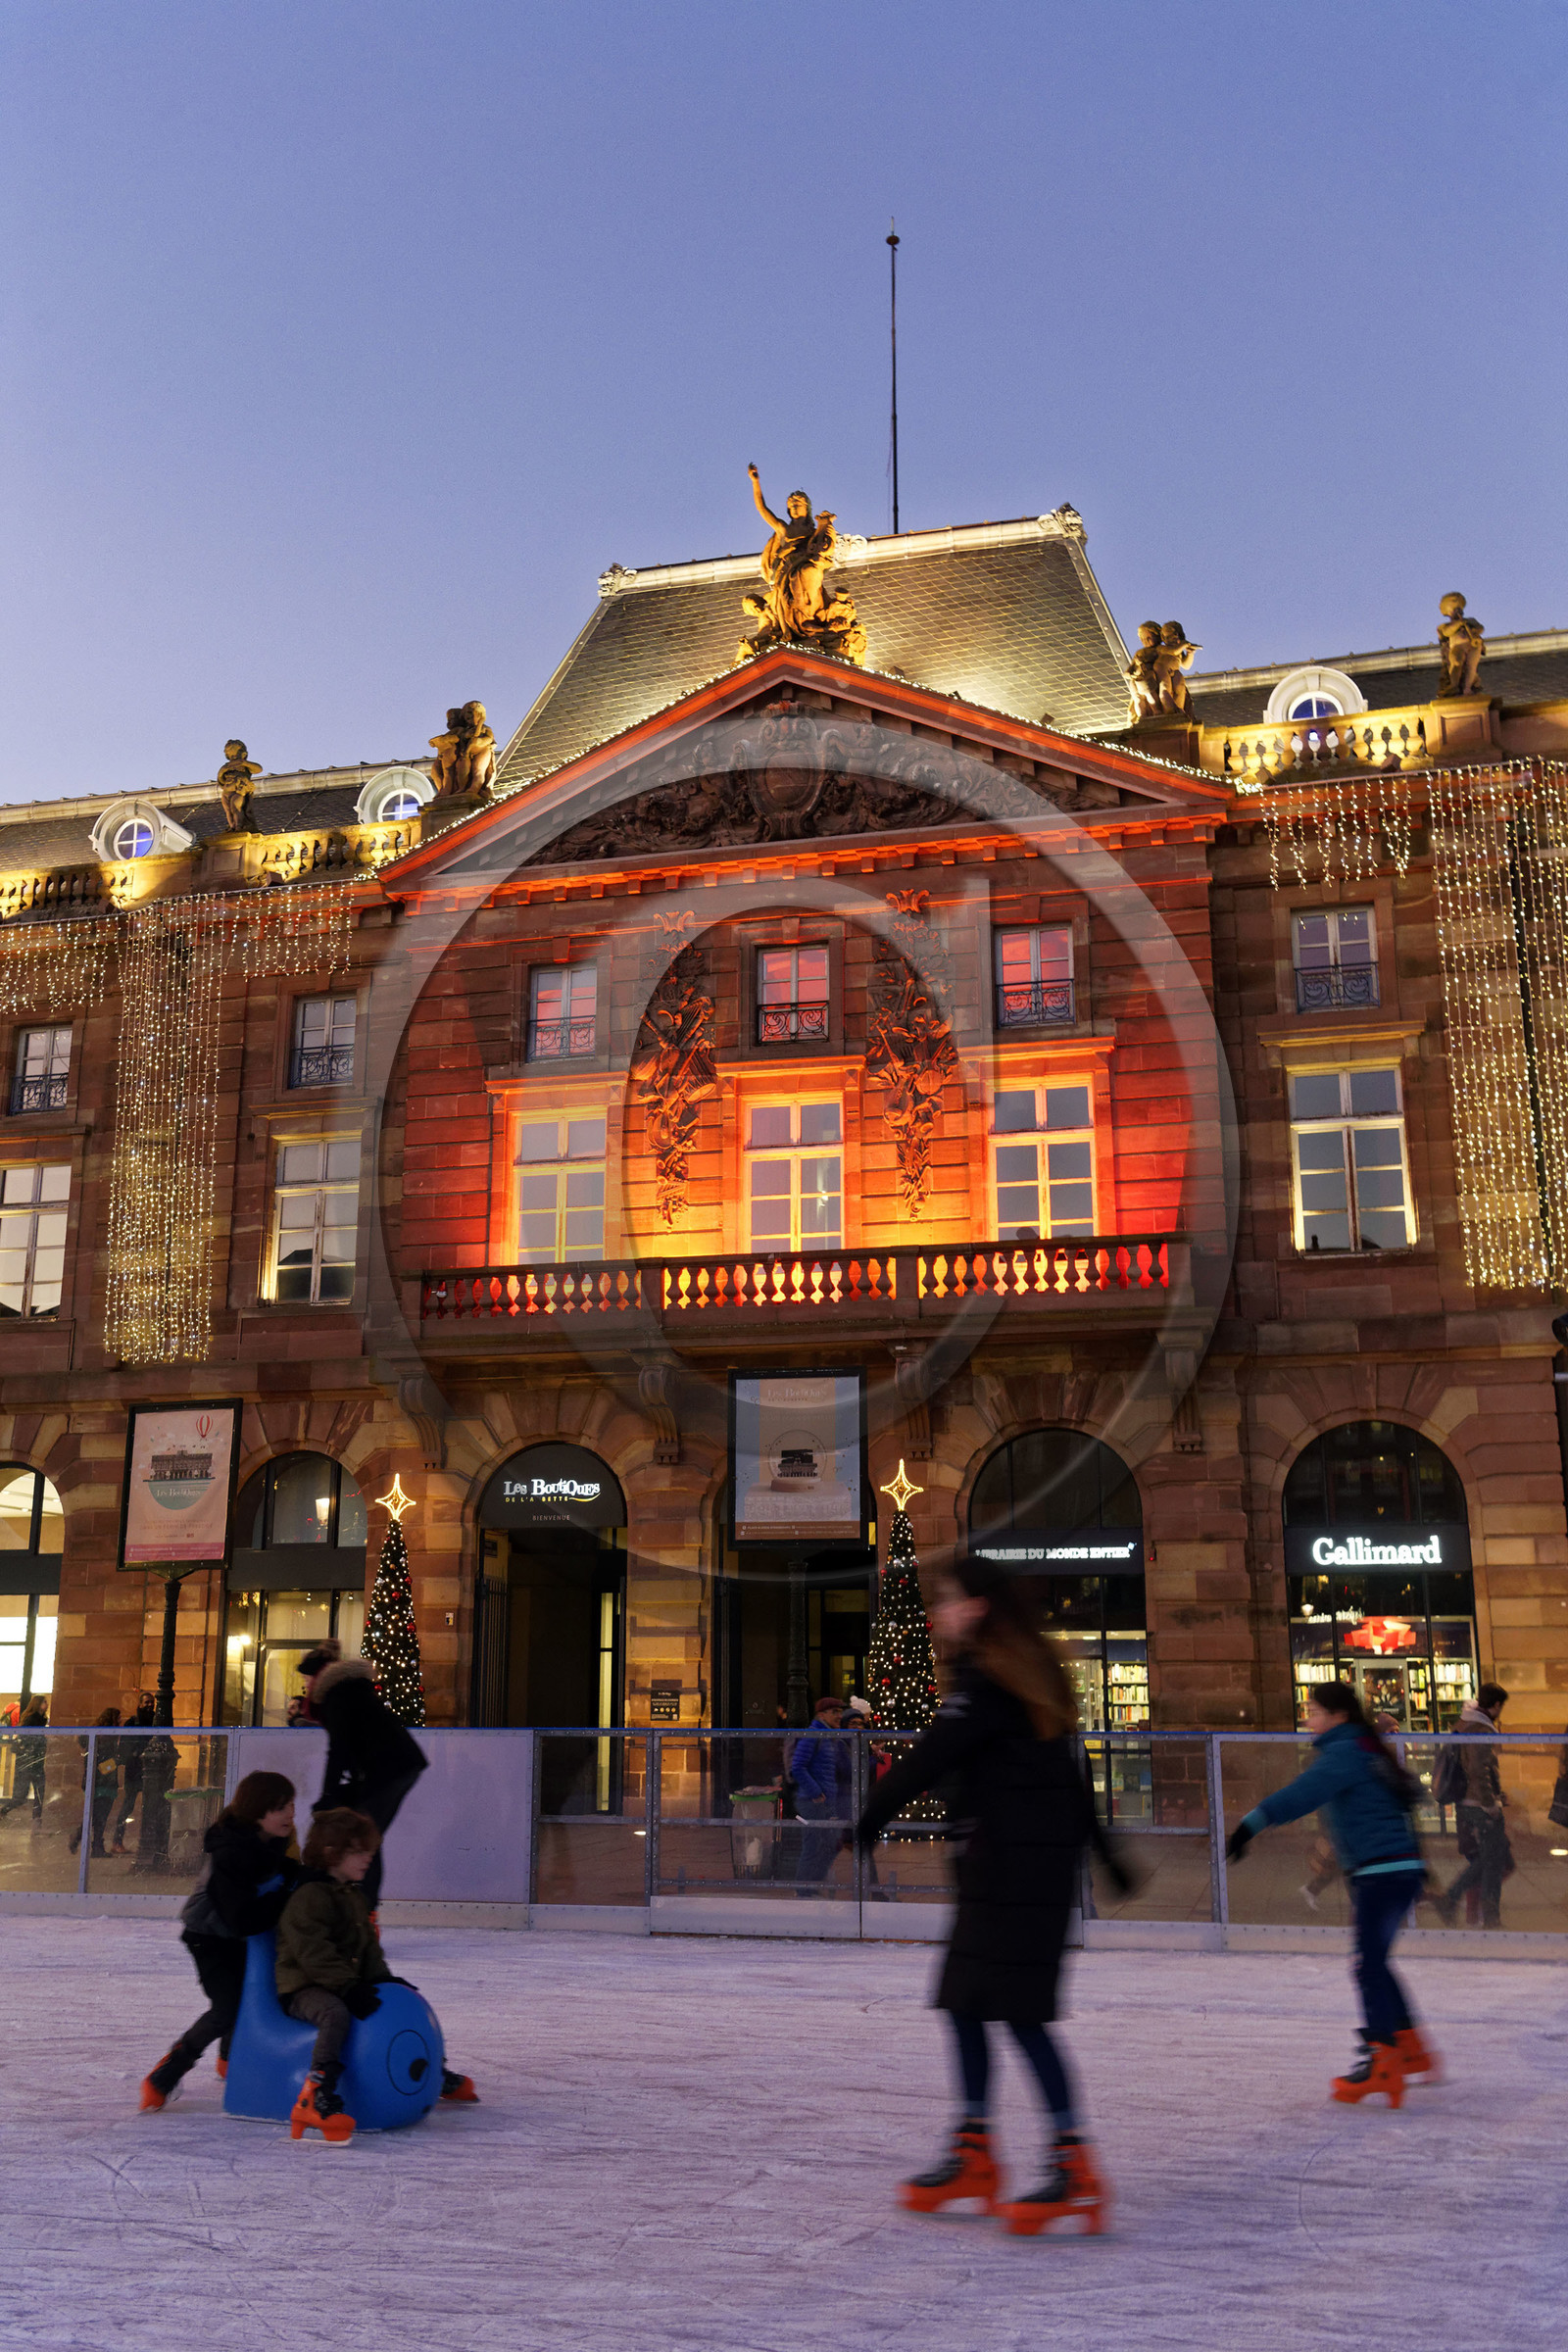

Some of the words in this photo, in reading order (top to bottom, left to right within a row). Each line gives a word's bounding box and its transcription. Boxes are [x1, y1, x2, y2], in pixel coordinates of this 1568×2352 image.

[504, 1481, 527, 1495] Les
[1028, 1548, 1045, 1560] DU
[1046, 1547, 1089, 1559] MONDE
[1090, 1546, 1131, 1559] ENTIER
[1312, 1535, 1443, 1565] Gallimard
